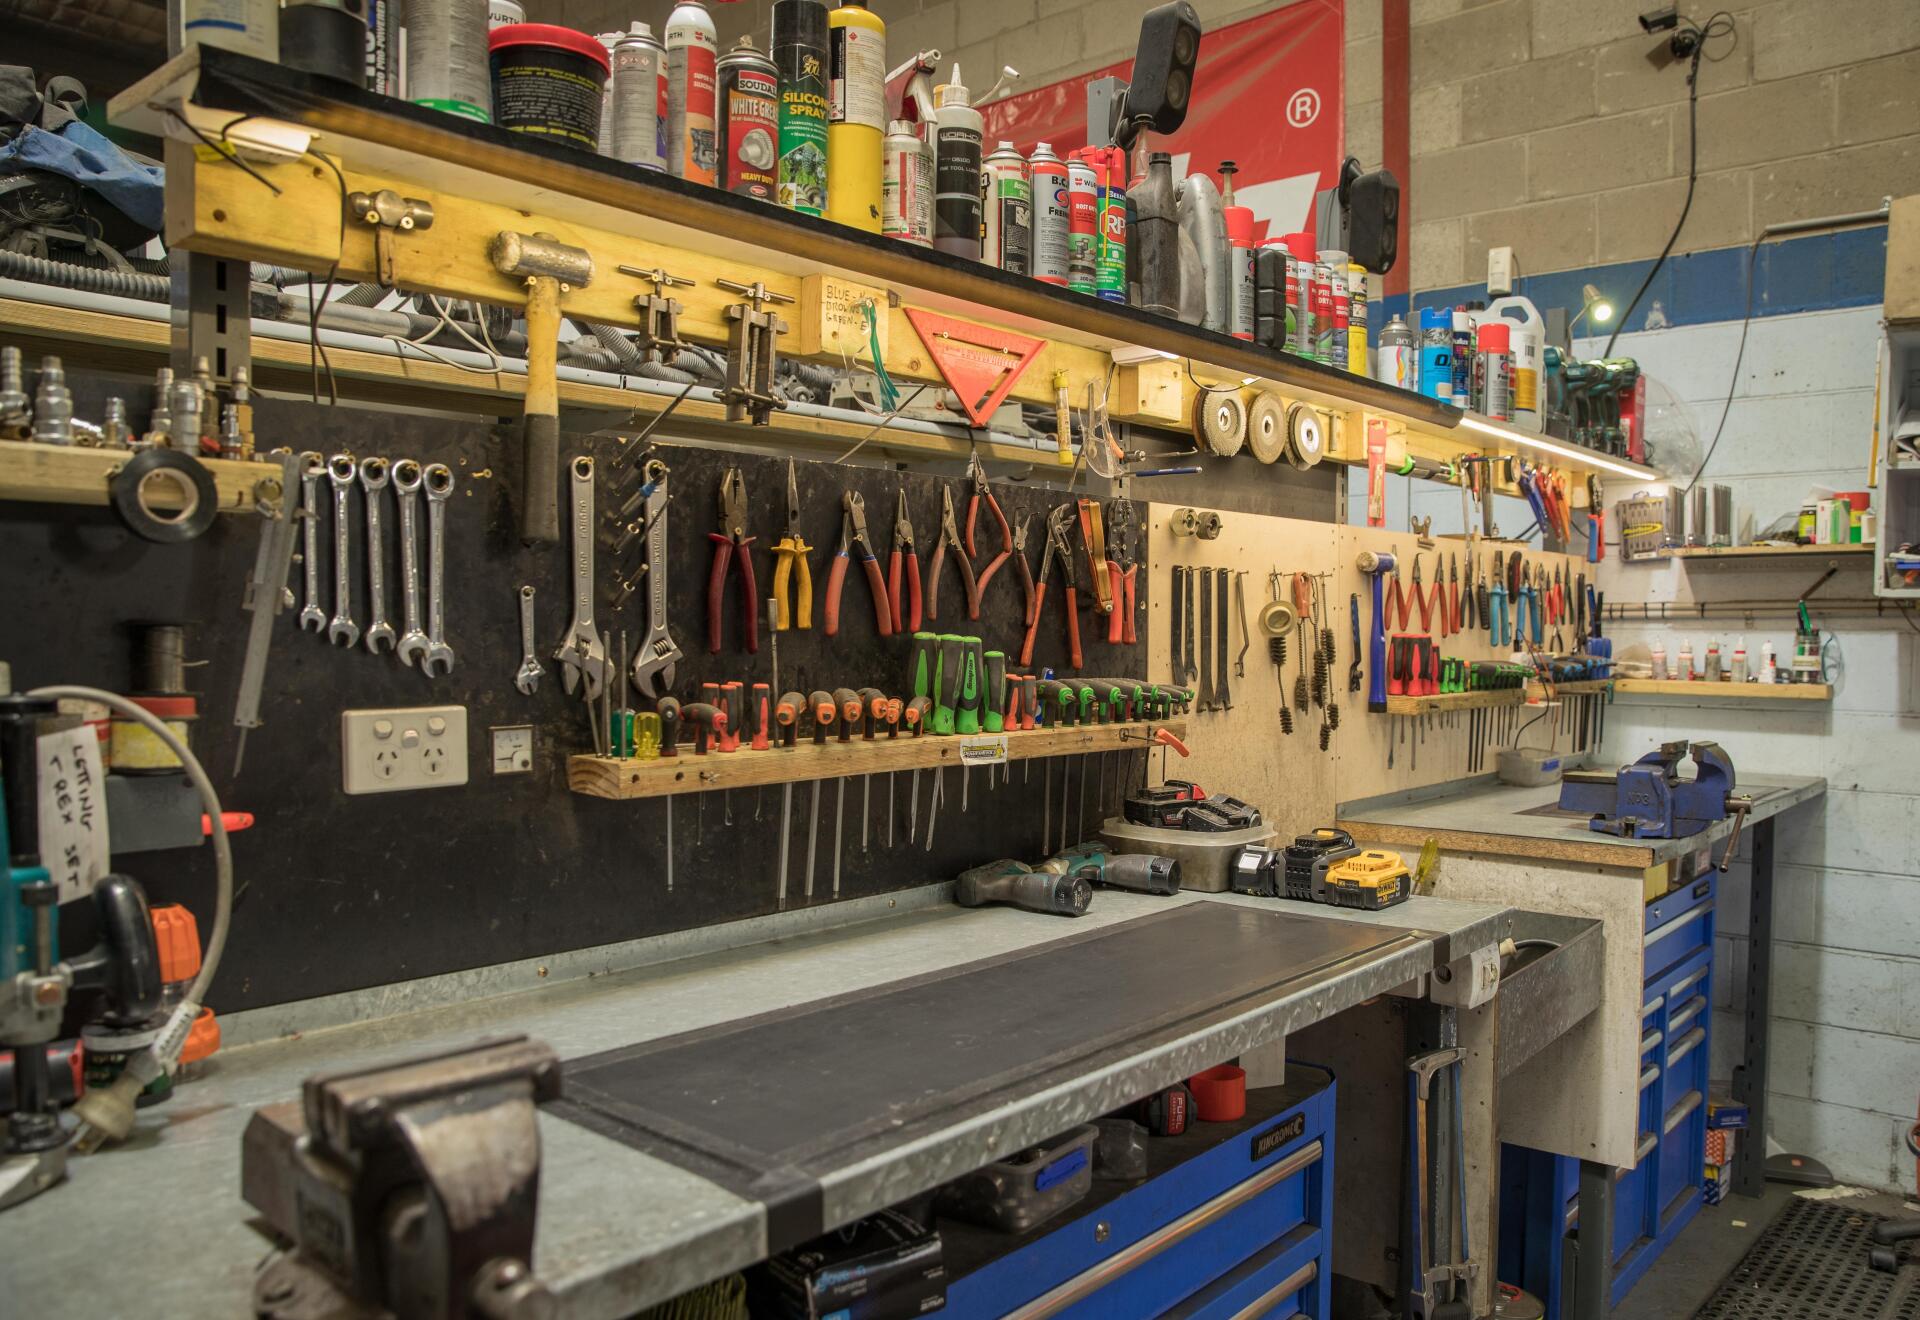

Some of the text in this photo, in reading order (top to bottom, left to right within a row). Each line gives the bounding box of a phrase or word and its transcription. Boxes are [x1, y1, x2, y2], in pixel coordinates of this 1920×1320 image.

[739, 79, 777, 96] SOUDAL
[731, 98, 758, 116] WHITE
[789, 104, 826, 120] SPRAY
[741, 172, 761, 182] HEAVY
[826, 284, 850, 302] BLUE
[1175, 1096, 1184, 1130] FUEL
[1257, 1121, 1296, 1155] KINCROME
